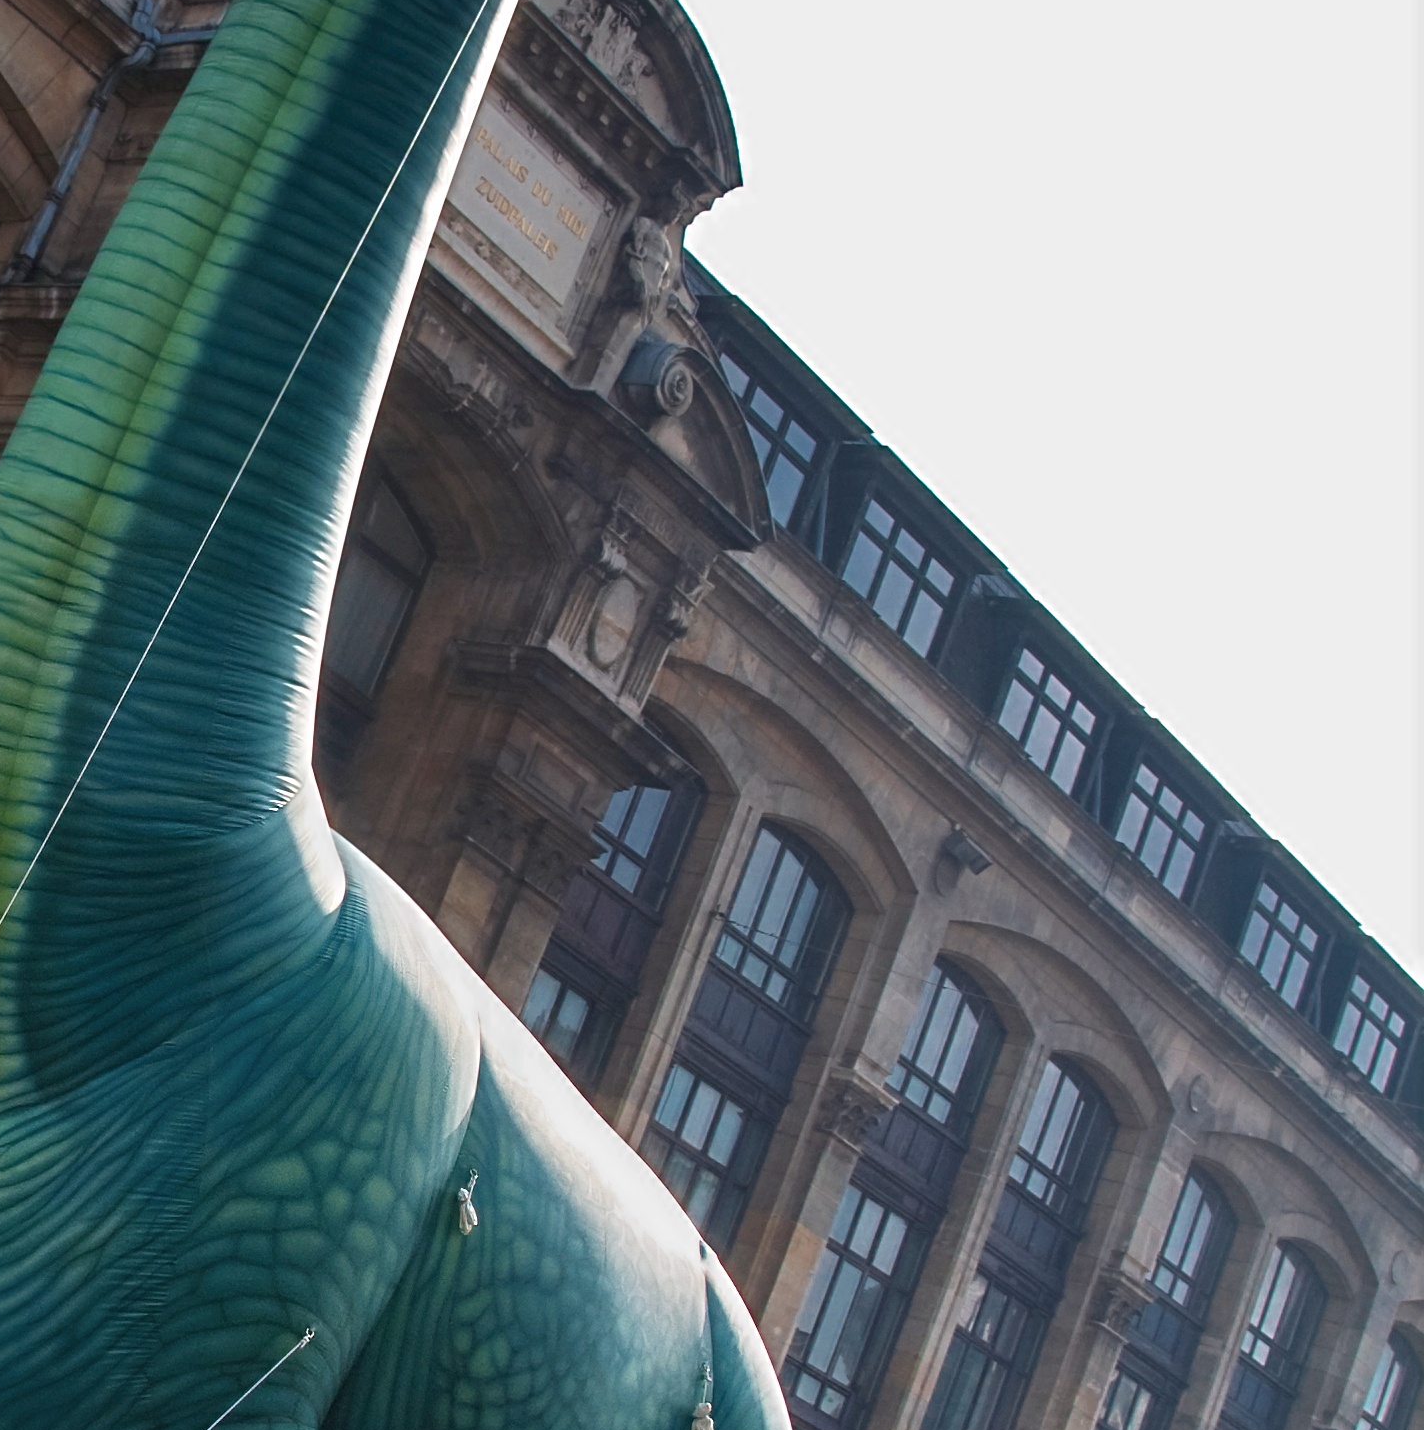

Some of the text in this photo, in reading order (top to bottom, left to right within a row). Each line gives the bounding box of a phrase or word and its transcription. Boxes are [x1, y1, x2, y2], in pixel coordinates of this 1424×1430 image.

[475, 126, 589, 241] PALAIS DU MIDI
[475, 175, 558, 261] ZUIDPALEIS
